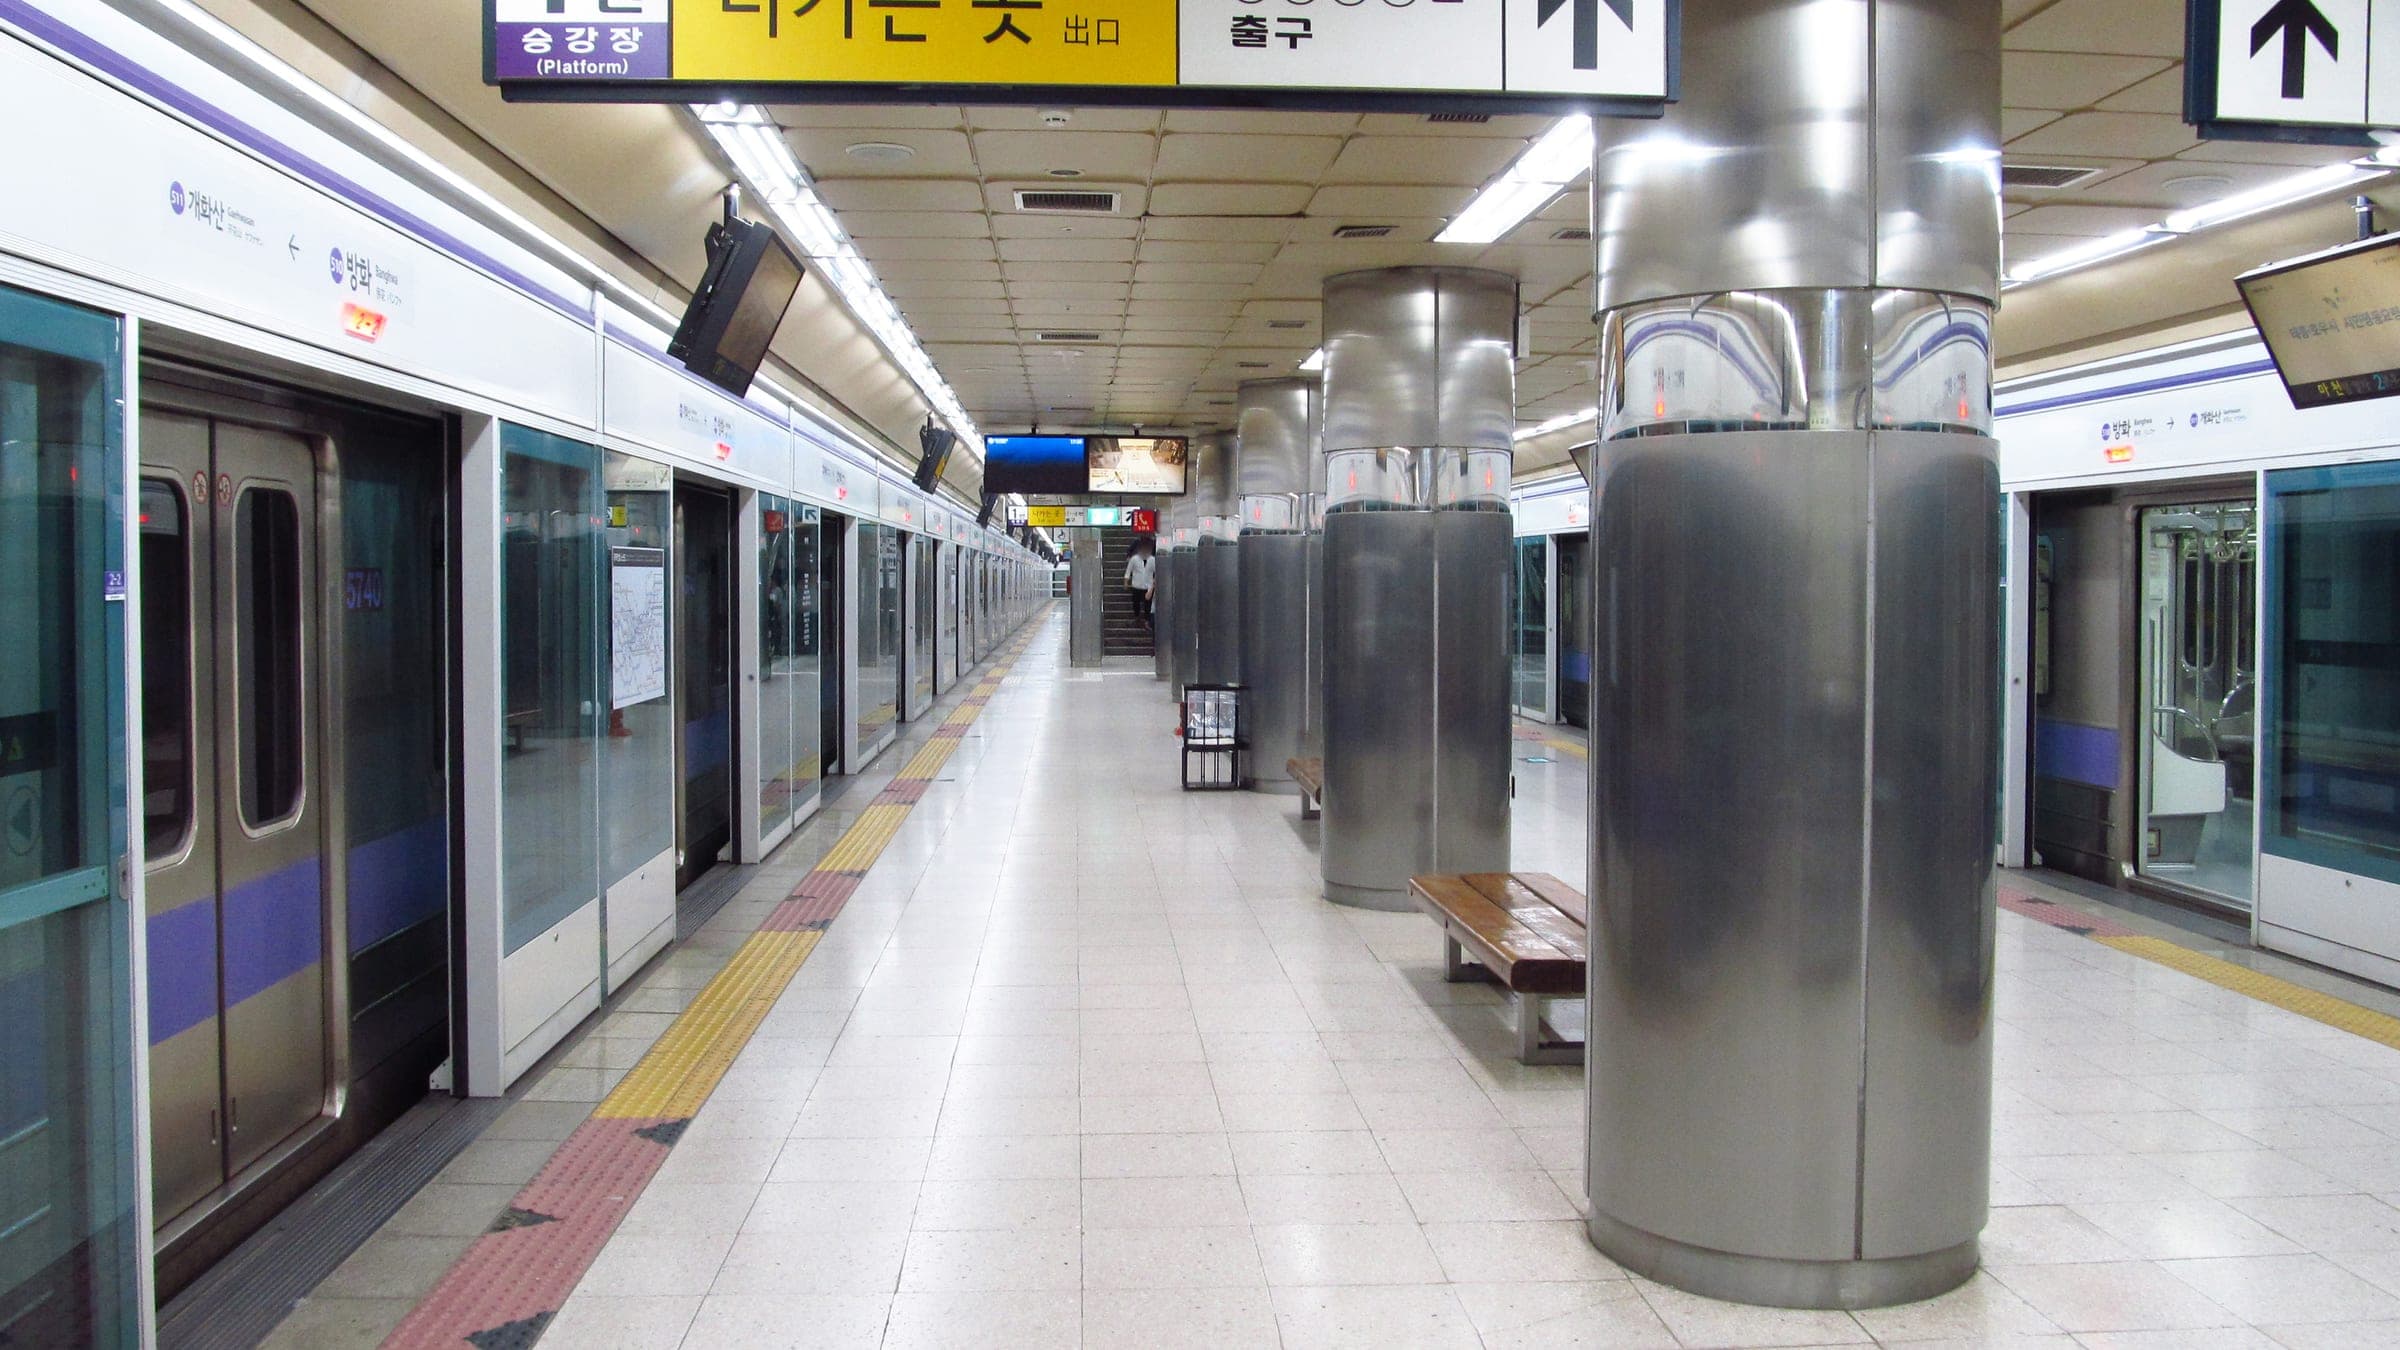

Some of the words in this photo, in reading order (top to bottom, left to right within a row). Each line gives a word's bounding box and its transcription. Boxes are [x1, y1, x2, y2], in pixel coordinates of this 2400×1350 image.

[522, 27, 643, 54] 승강장
[1064, 14, 1120, 46] 出口
[1230, 14, 1313, 49] 출구
[536, 58, 628, 76] (Platform)
[188, 189, 225, 232] 개화산
[346, 251, 373, 295] 방화
[109, 573, 122, 586] 2-2
